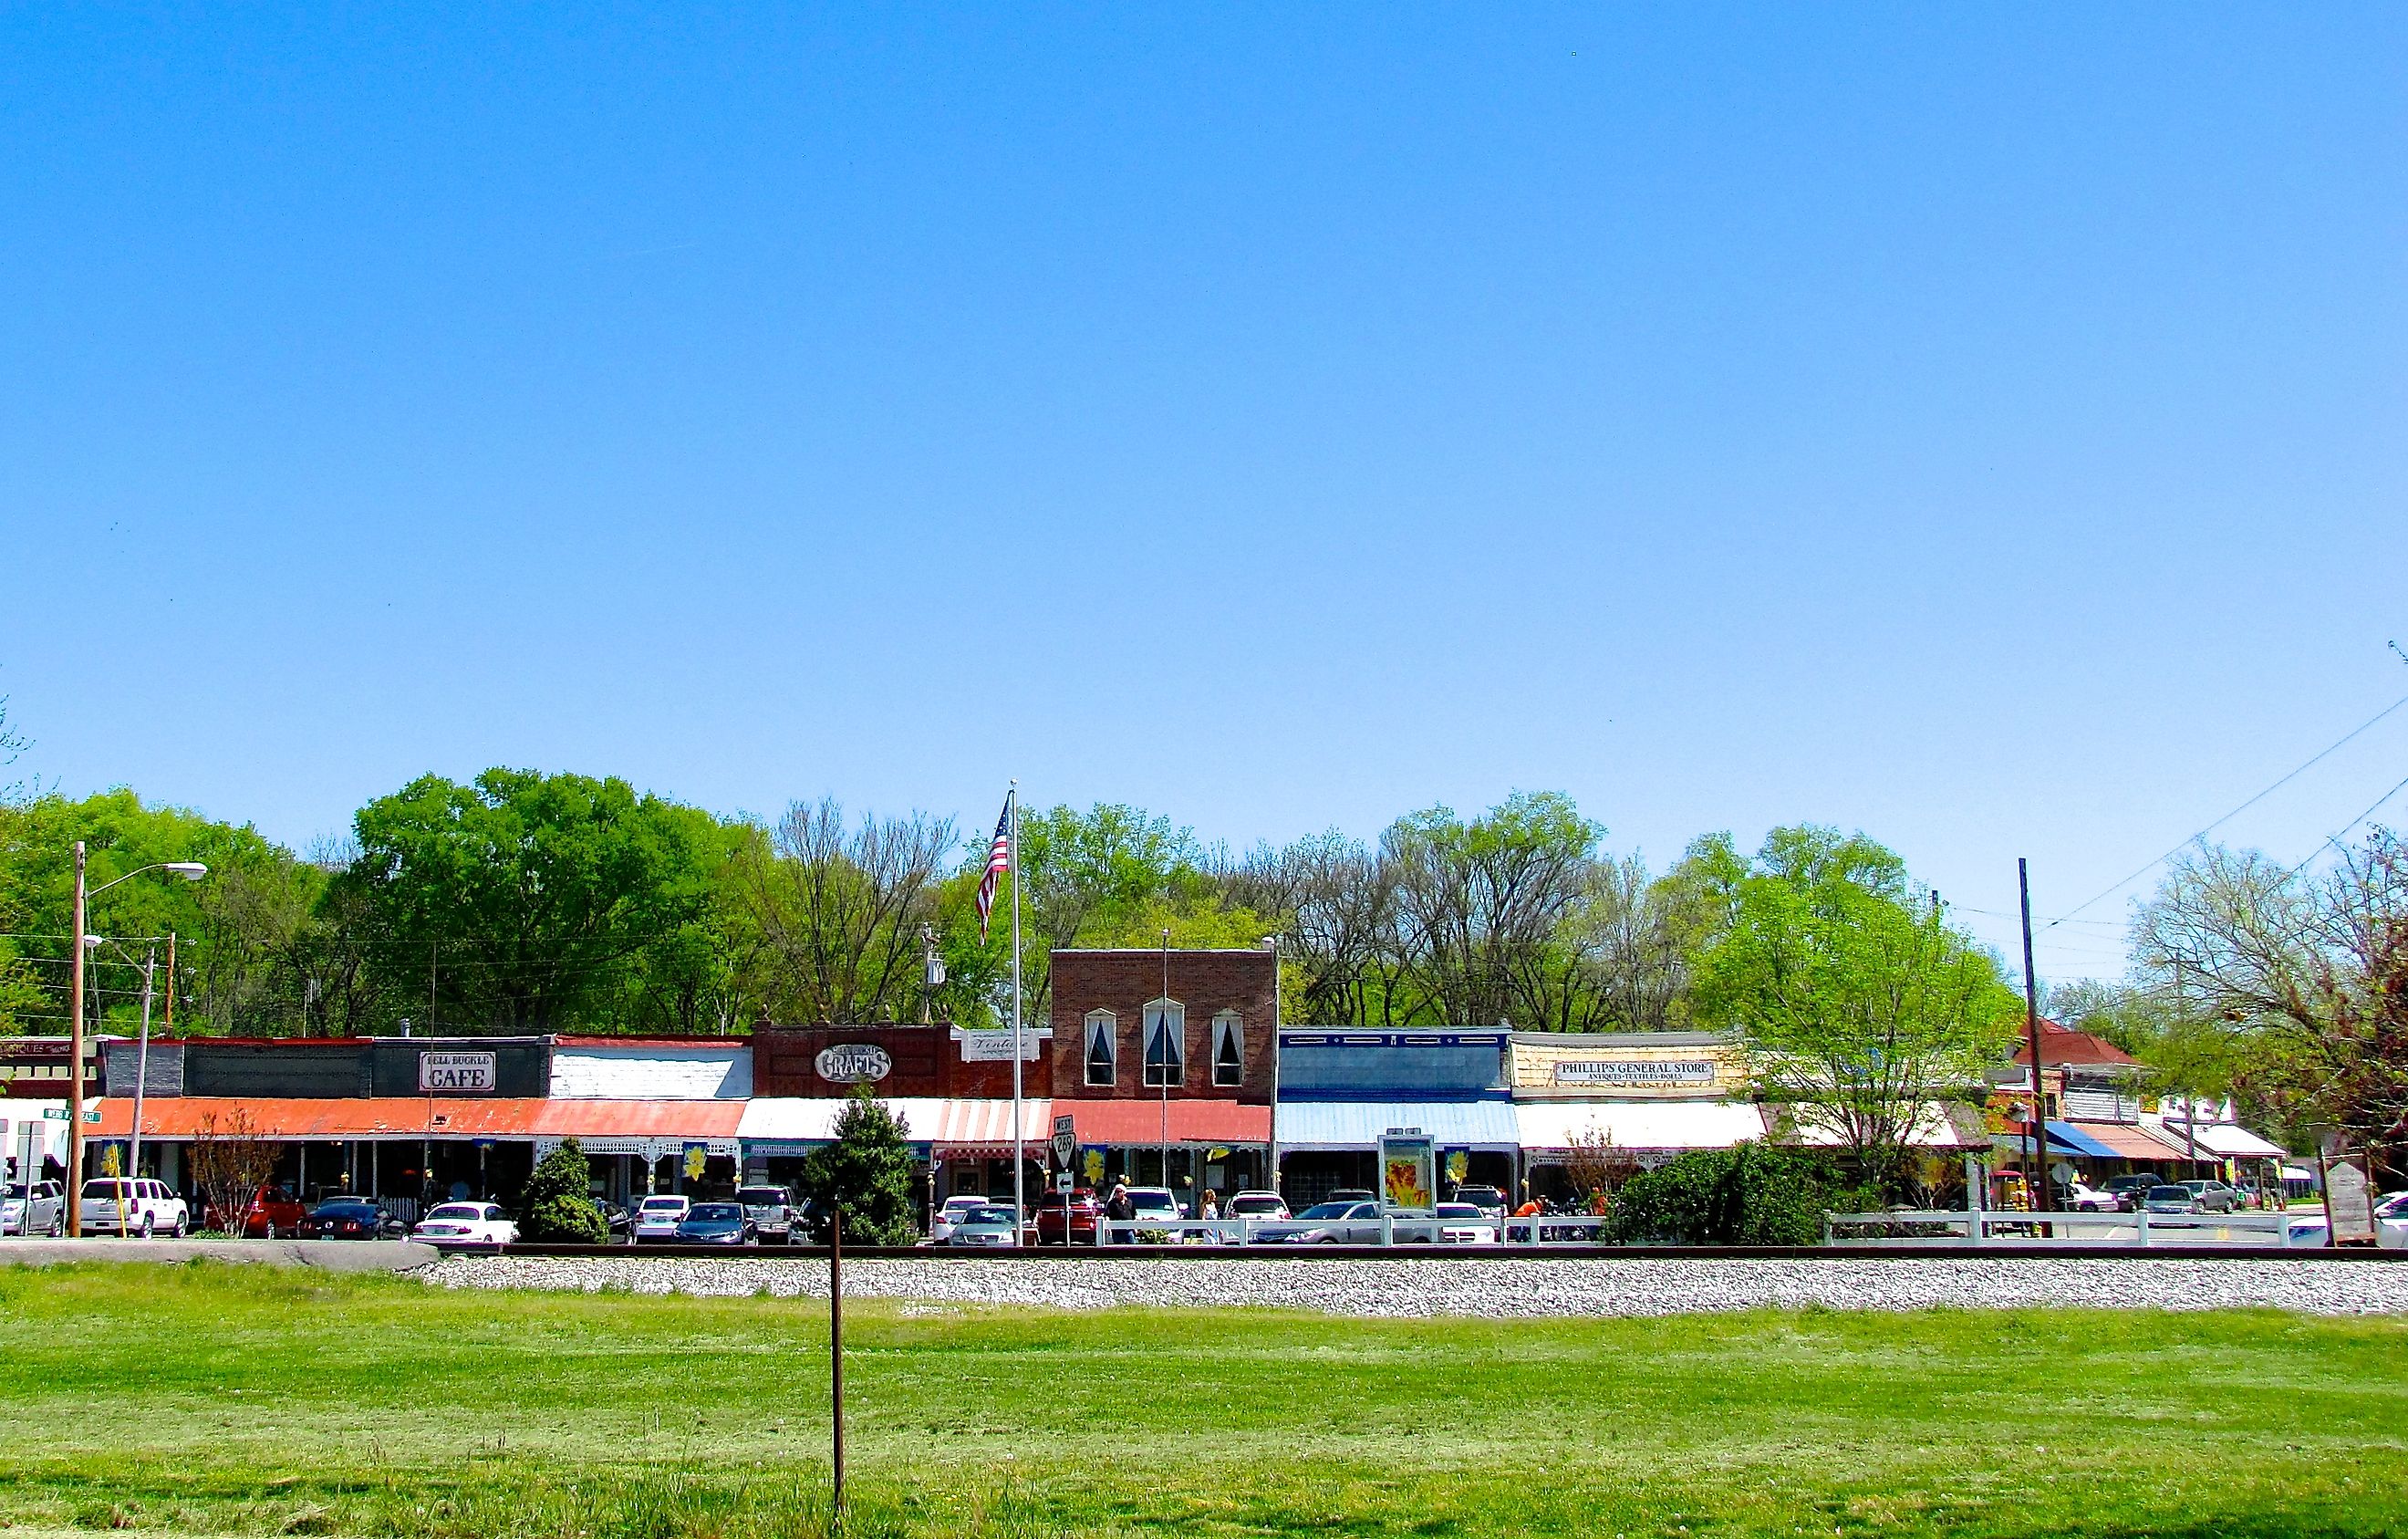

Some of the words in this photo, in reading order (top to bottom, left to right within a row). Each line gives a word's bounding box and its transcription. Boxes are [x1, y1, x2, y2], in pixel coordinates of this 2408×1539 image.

[972, 1038, 1028, 1049] Vintae
[452, 1055, 489, 1065] BUCKLE
[815, 1049, 889, 1077] CRAFTS
[1562, 1063, 1615, 1073] PHILLIPS
[1617, 1063, 1671, 1073] GENERAL
[1674, 1063, 1707, 1073] STORE
[429, 1069, 485, 1087] CAFE
[1056, 1118, 1071, 1130] WEST
[1057, 1135, 1073, 1153] 269
